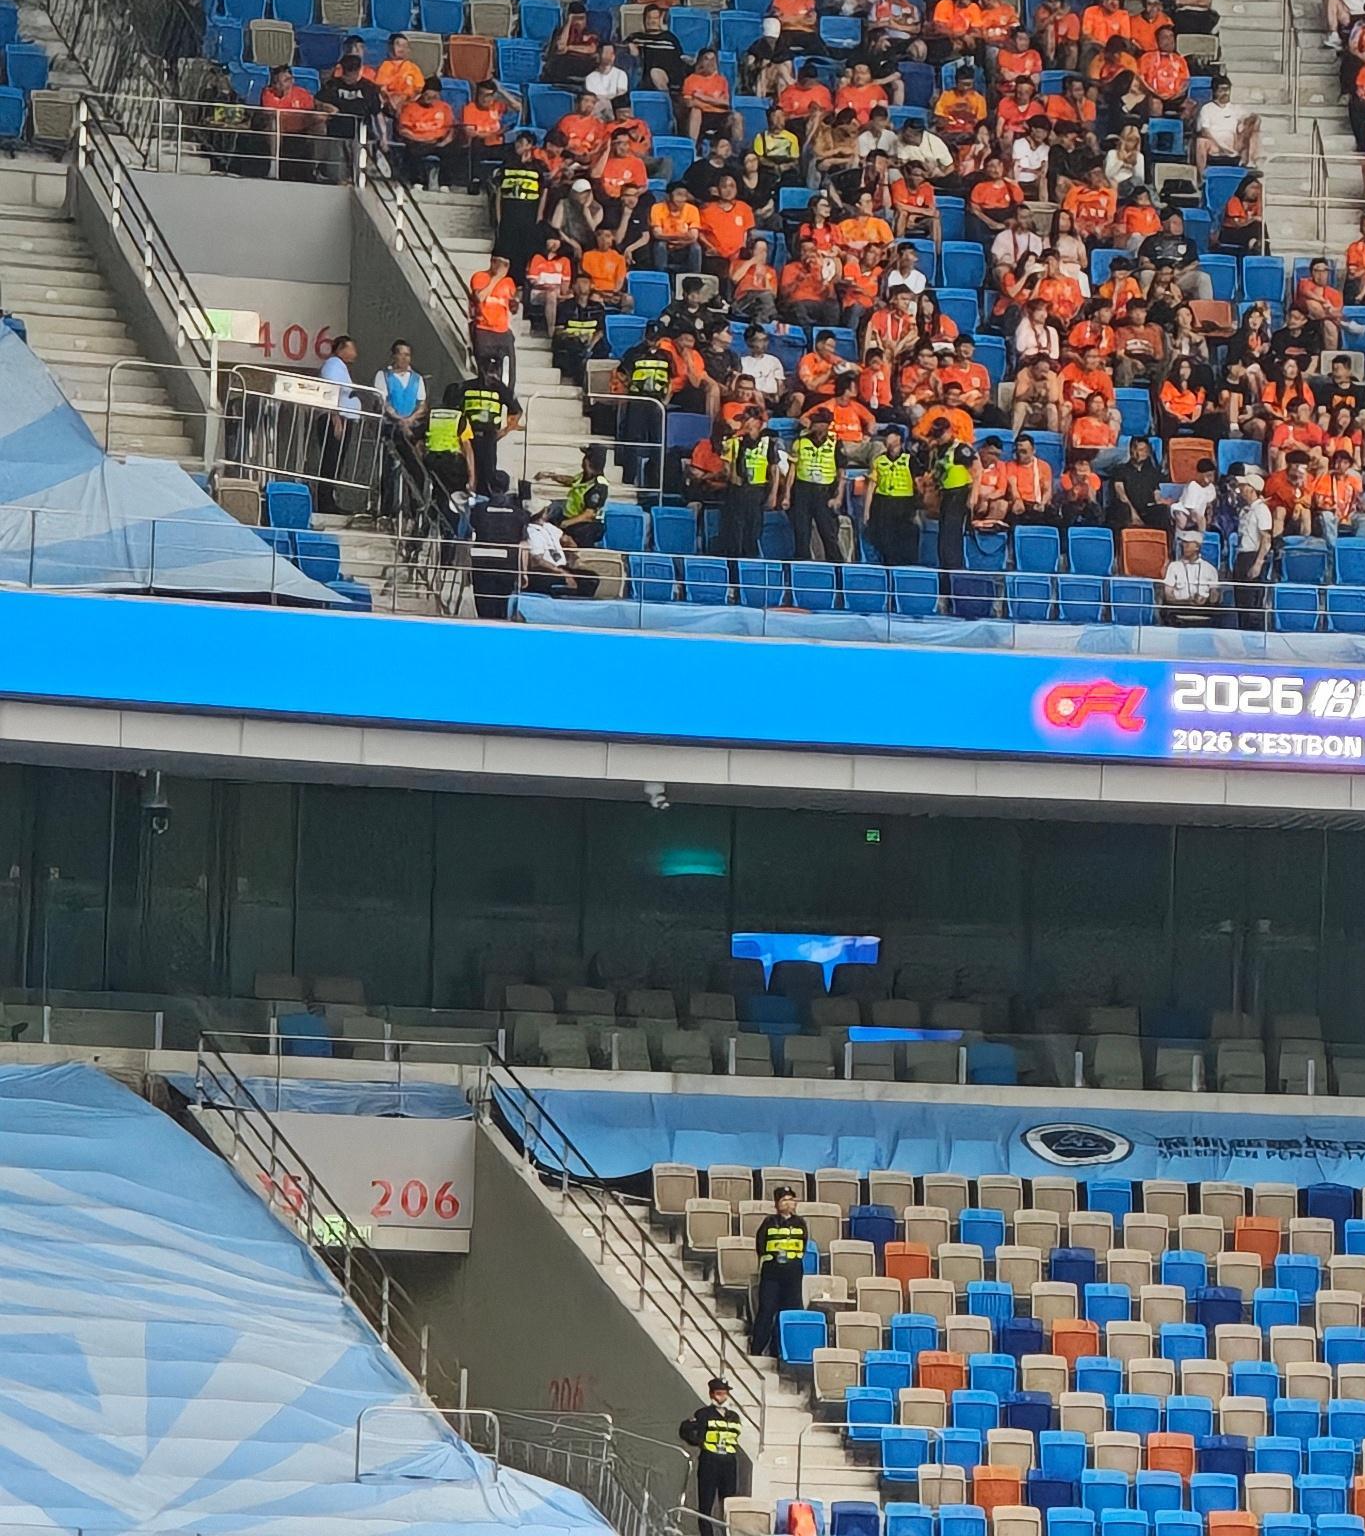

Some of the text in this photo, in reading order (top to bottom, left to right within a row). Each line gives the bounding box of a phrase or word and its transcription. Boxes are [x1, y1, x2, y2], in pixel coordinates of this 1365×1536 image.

[1172, 673, 1304, 715] 2026
[1172, 729, 1232, 753] 2026
[1238, 732, 1361, 758] C'ESTBON
[370, 1179, 460, 1220] 206
